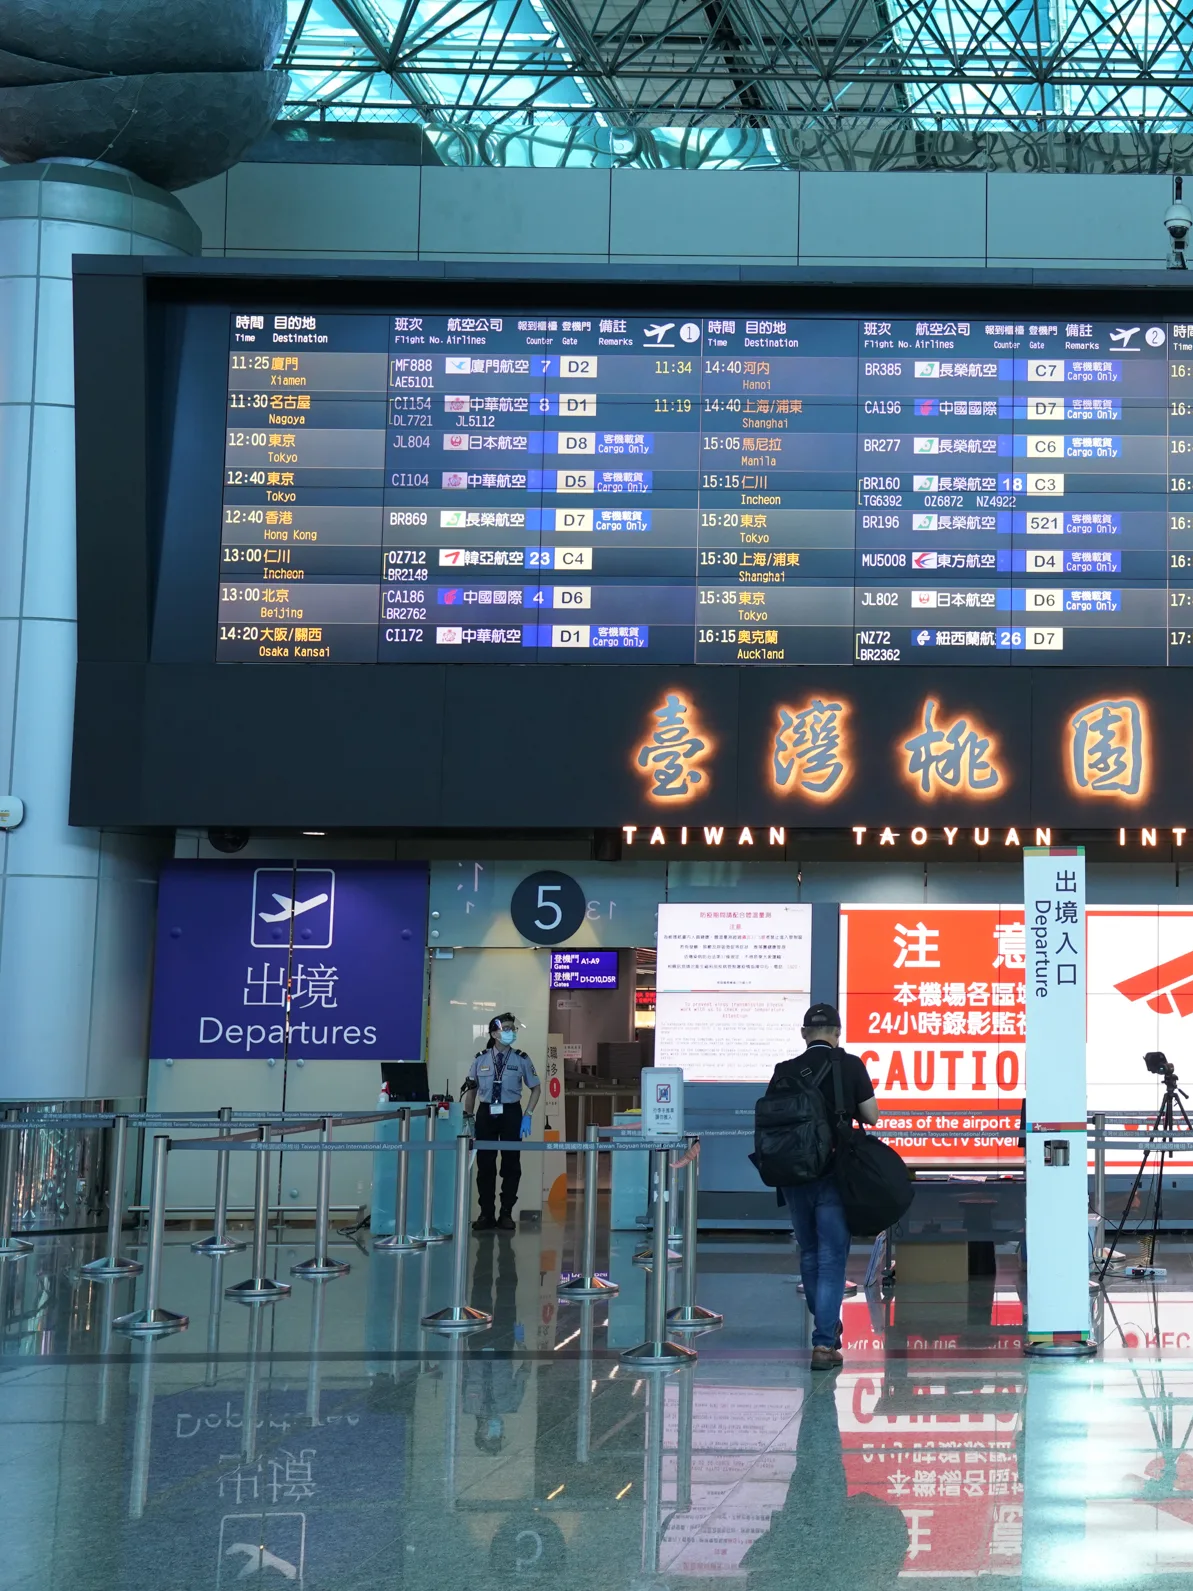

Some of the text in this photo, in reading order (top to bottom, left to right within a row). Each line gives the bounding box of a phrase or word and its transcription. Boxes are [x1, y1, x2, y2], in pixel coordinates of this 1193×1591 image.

[236, 316, 316, 330] 時間 目的地
[235, 334, 328, 343] Time Destination
[232, 357, 299, 371] 11:25 廈門
[395, 360, 432, 371] MF888
[568, 361, 589, 373] D2
[705, 361, 741, 373] 14:40
[271, 375, 306, 386] Xiamen
[742, 380, 771, 390] Hanoi
[230, 395, 311, 409] 11:30 名古屋
[269, 414, 305, 425] Nagoya
[741, 455, 777, 466] Manila
[701, 514, 767, 527] 15:20 東京
[1030, 518, 1058, 530] 521
[529, 552, 550, 565] 23
[701, 552, 800, 566] 15:30 上海/浦東
[862, 555, 906, 567] MU5008
[260, 608, 303, 619] Beijing
[386, 629, 423, 642] CI172
[699, 630, 778, 644] 16:15 奧克蘭
[861, 632, 891, 644] NZ72
[737, 649, 784, 660] Auckland
[623, 825, 786, 845] TAIWAN
[853, 826, 1052, 847] TAOYUAN
[534, 885, 562, 930] 5
[1054, 870, 1078, 986] 出境入口
[1031, 899, 1052, 999] Departure
[554, 955, 579, 963] 登機門
[554, 972, 579, 981] 登機門
[243, 962, 339, 1010] 出境
[199, 1016, 377, 1050] Departures
[860, 1050, 1026, 1091] CAUTIO
[876, 1118, 912, 1128] areas
[917, 1116, 932, 1128] of
[936, 1116, 958, 1128] the
[963, 1116, 1010, 1131] airport
